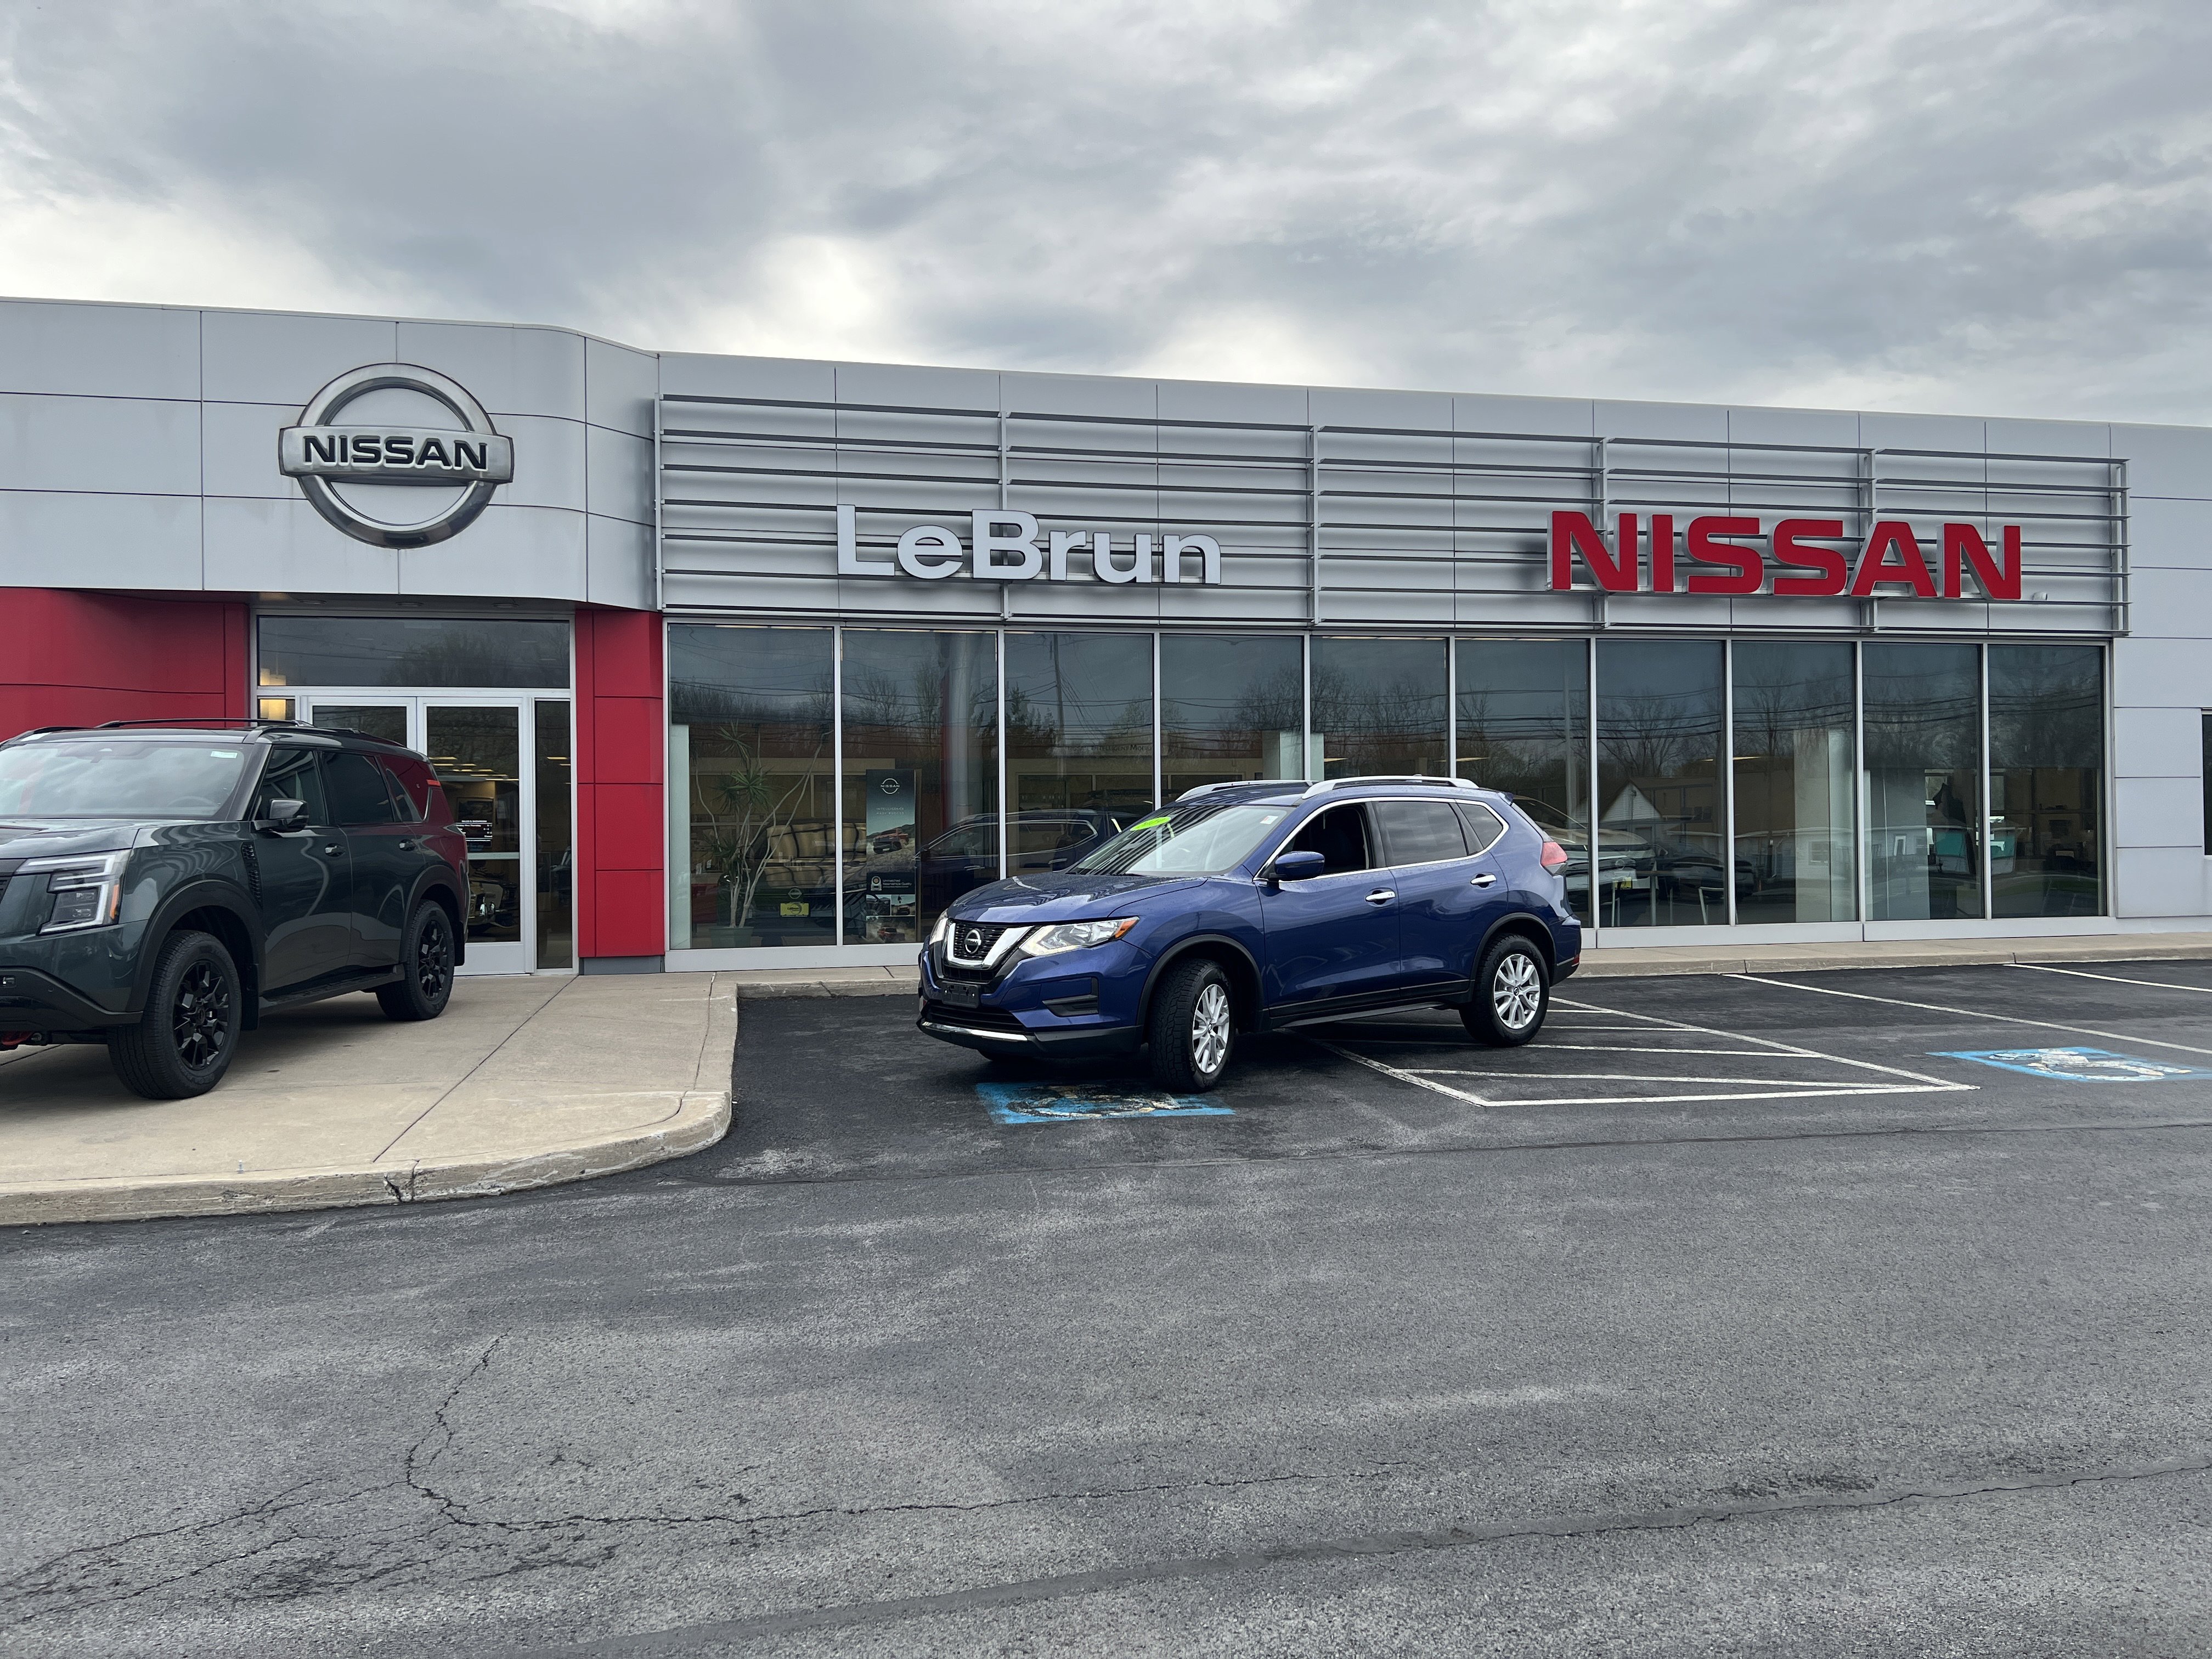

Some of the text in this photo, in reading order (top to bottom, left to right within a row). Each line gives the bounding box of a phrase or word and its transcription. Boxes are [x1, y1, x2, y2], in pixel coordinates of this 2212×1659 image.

[303, 435, 488, 470] NISSAN
[837, 504, 1221, 584] LeBrun
[1548, 511, 2022, 600] NISSAN
